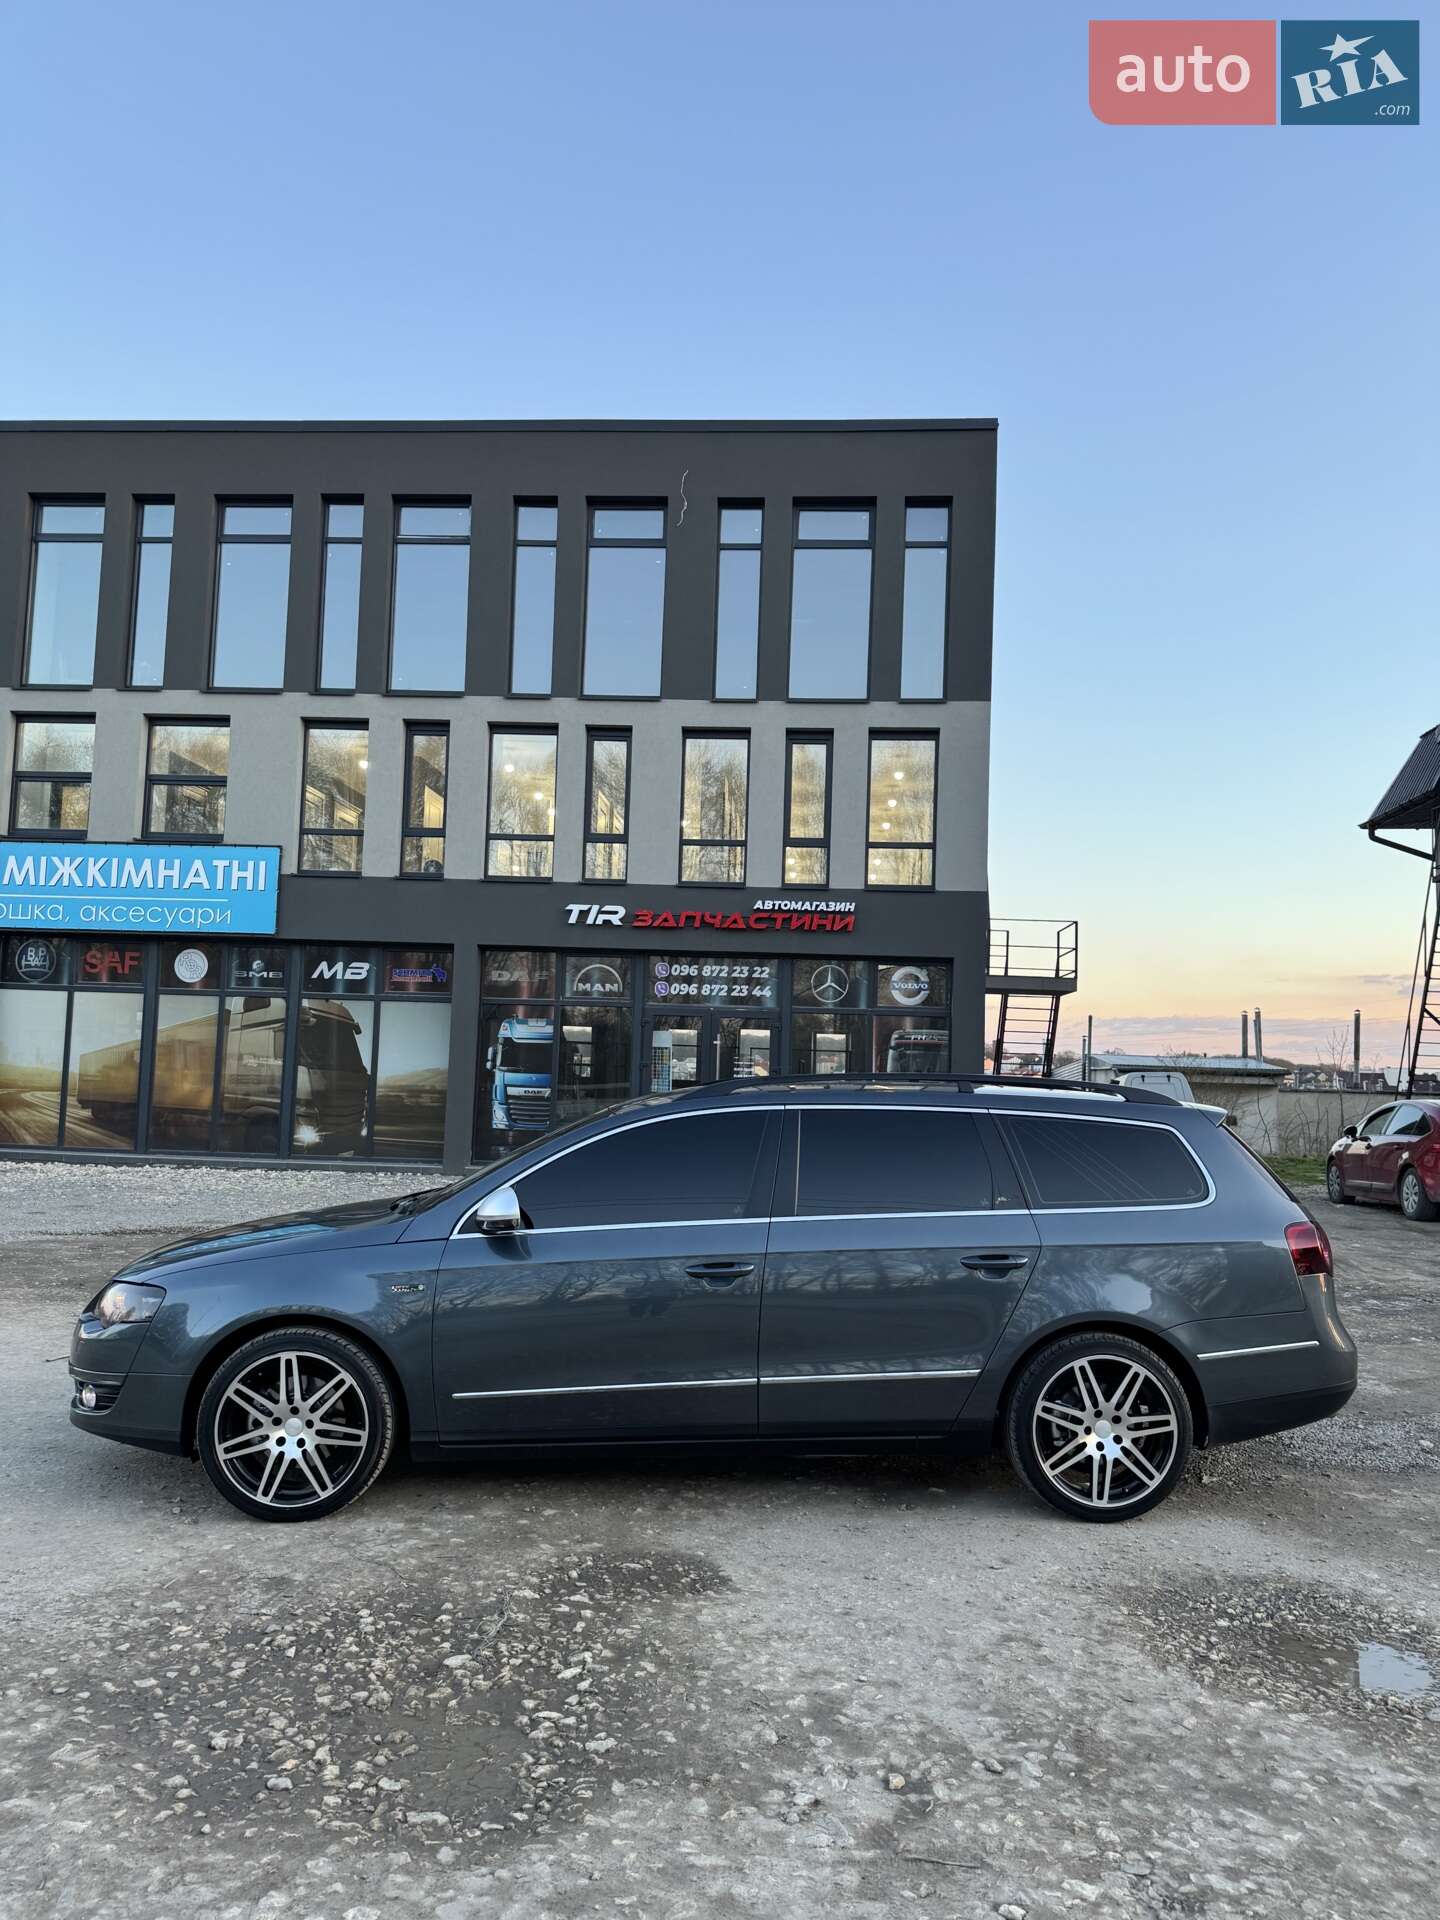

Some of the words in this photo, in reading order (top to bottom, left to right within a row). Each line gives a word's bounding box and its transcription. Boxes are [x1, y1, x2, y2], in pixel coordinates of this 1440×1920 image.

[3, 855, 267, 891] МІЖКІМНАТНІ
[753, 899, 856, 912] АВТОМАГАЗИН
[79, 903, 232, 929] аксесуари
[565, 903, 626, 926] TIR
[631, 910, 856, 932] ЗАПЧАСТИНИ
[84, 951, 142, 976] SAF
[311, 960, 370, 980] MB
[671, 964, 699, 976] 096
[701, 965, 728, 977] 872
[731, 966, 749, 978] 23
[751, 966, 770, 978] 22
[577, 982, 619, 992] MAN
[670, 983, 698, 995] 096
[701, 984, 728, 996] 872
[730, 985, 748, 996] 23
[751, 986, 773, 997] 44
[892, 982, 929, 990] VOLVO
